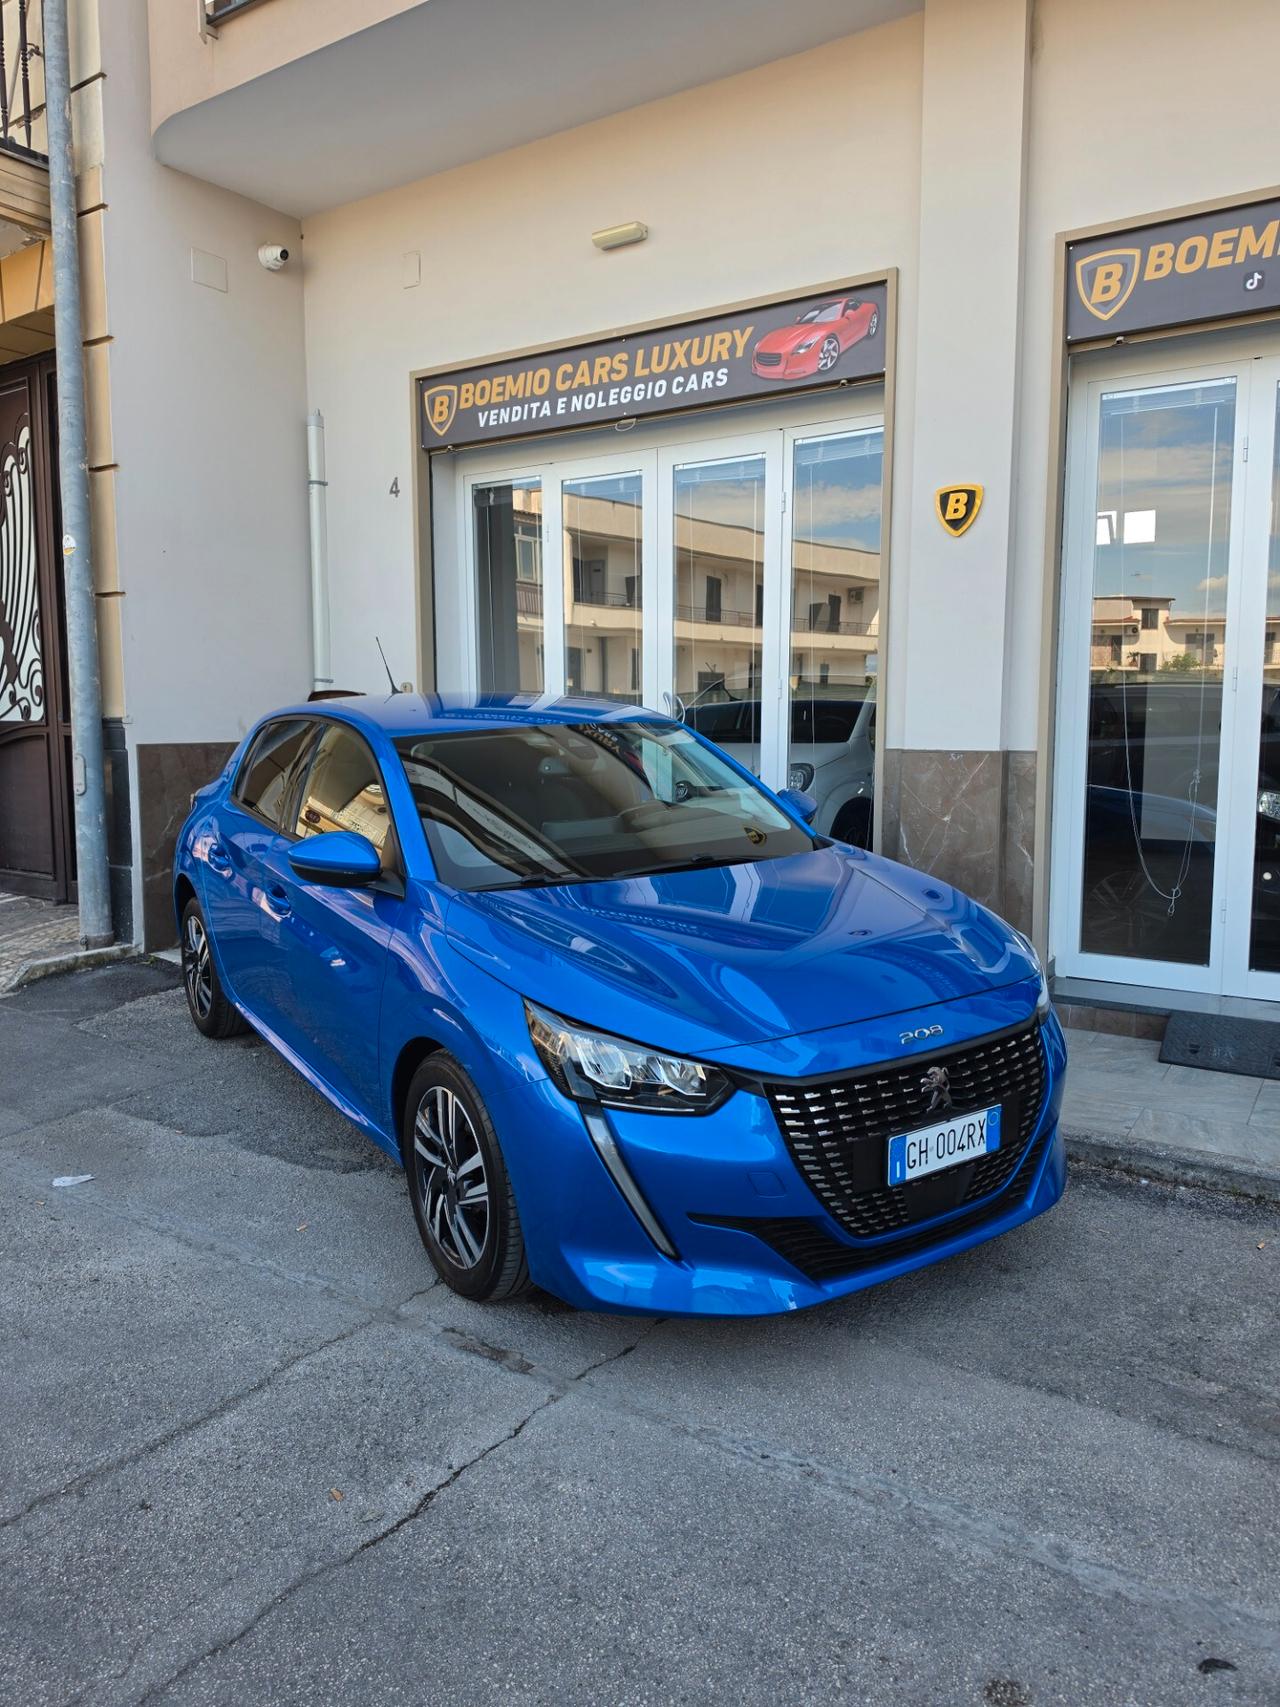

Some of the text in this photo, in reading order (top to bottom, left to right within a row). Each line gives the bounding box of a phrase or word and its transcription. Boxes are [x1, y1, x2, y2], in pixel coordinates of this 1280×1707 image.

[1143, 219, 1280, 281] BOEM
[1090, 263, 1124, 305] B
[459, 326, 754, 410] BOEMIO CARS LUXURY
[433, 395, 449, 424] B
[478, 367, 729, 428] VENDITA E NOLEGGIO CARS
[389, 476, 401, 498] 4
[945, 491, 968, 521] B
[899, 1024, 943, 1045] 208
